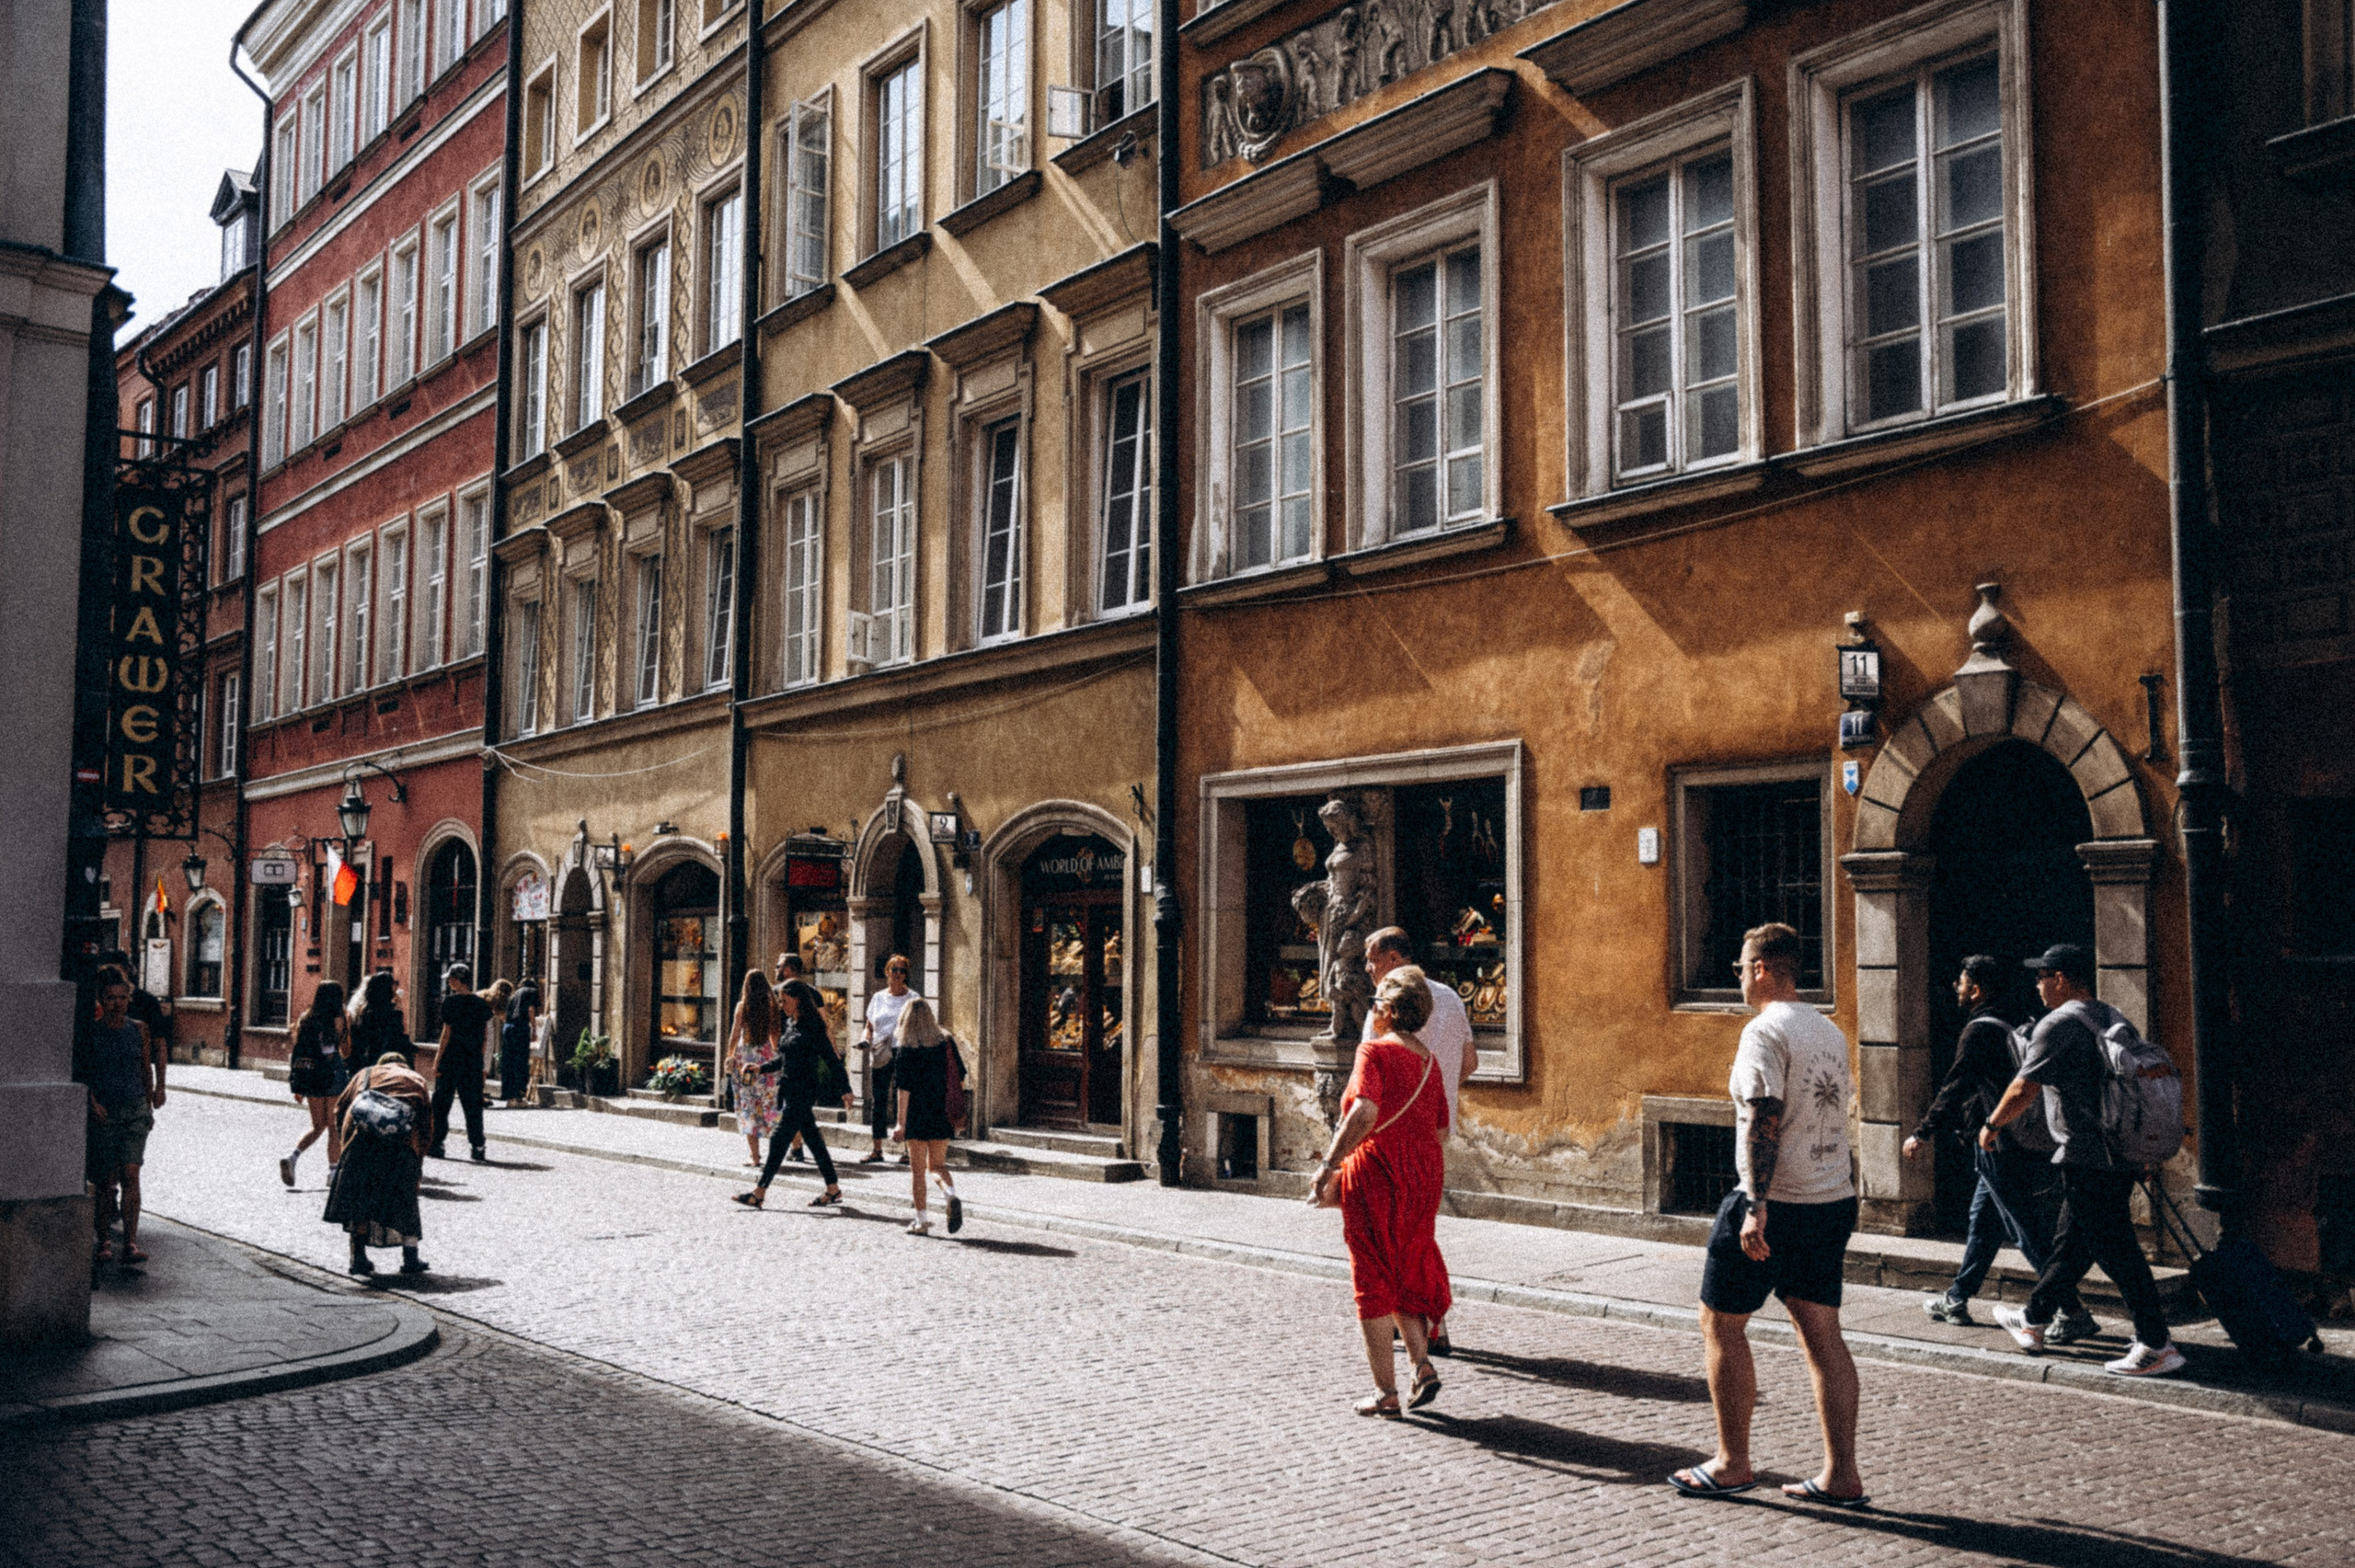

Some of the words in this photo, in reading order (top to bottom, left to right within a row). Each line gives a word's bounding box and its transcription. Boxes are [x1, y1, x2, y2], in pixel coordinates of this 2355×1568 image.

[119, 506, 169, 795] GRAWER
[1850, 654, 1867, 676] 11
[1851, 715, 1864, 735] 11
[939, 816, 948, 830] 9
[1040, 858, 1078, 874] WORLD
[1079, 857, 1094, 871] OF
